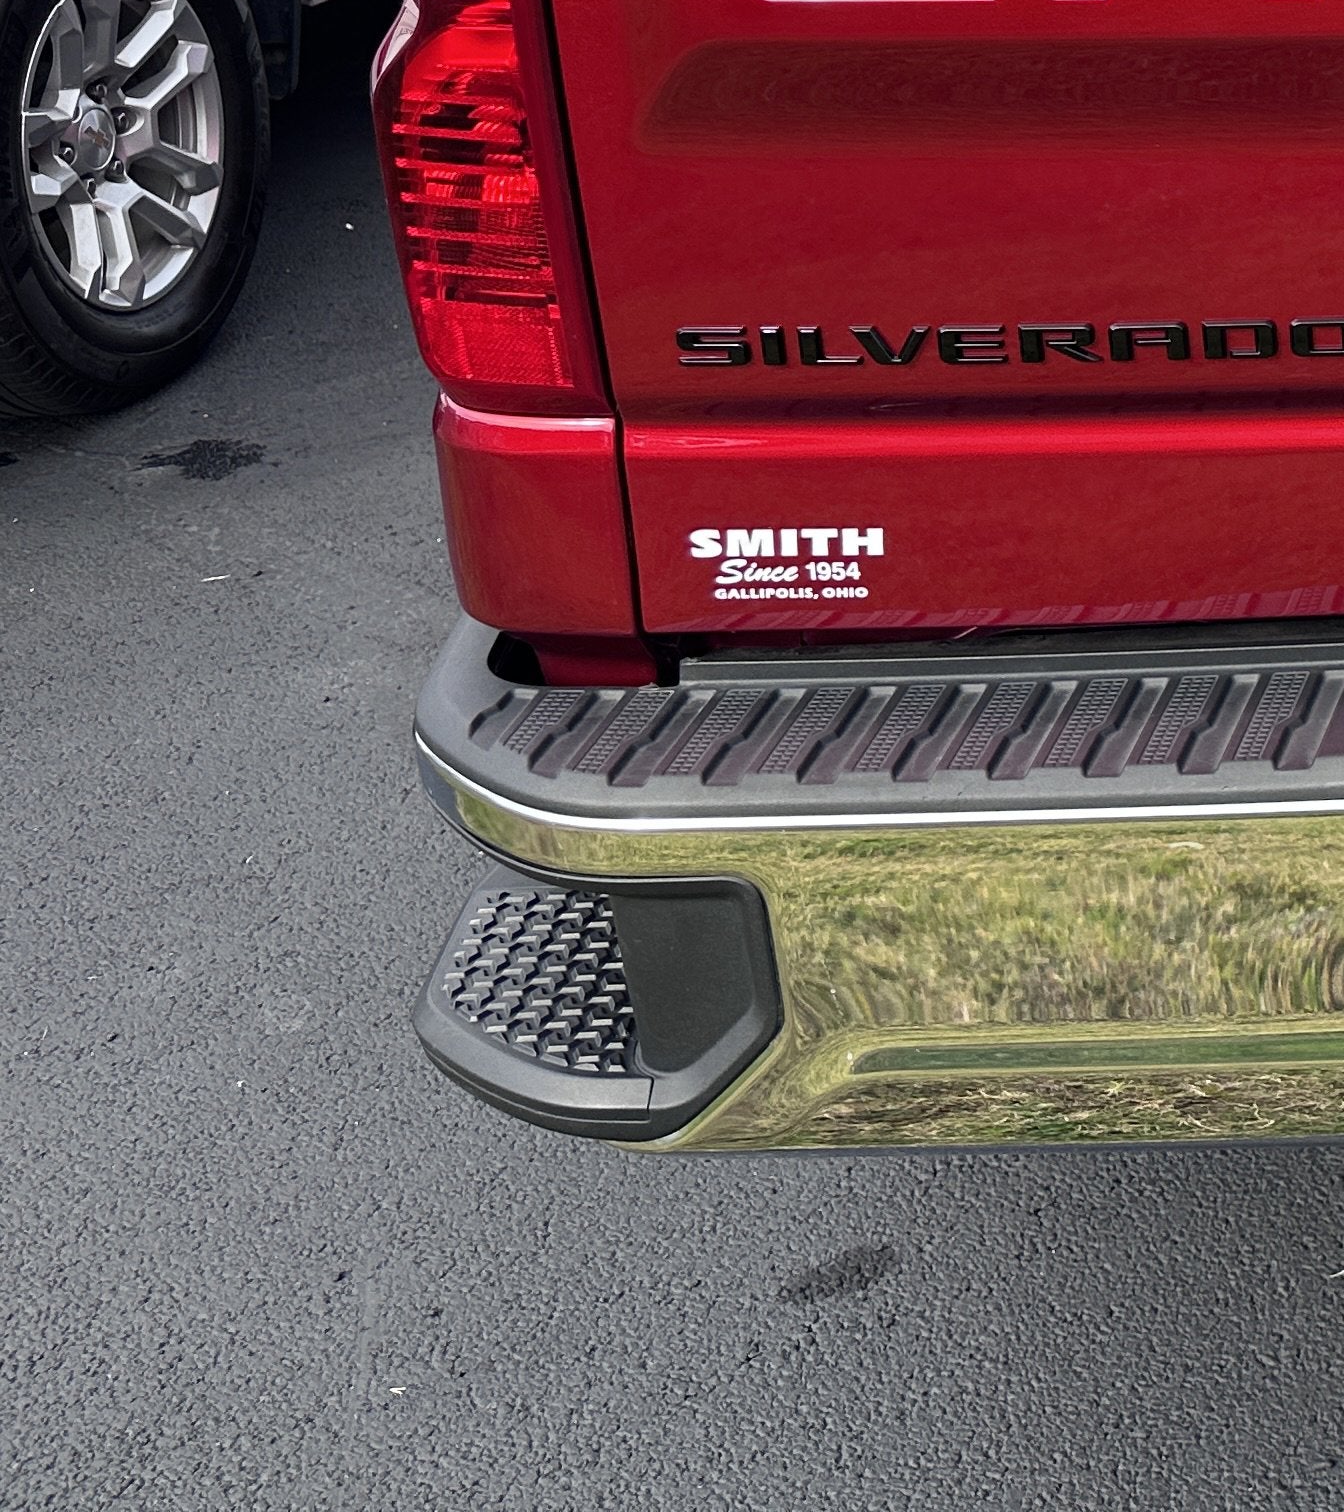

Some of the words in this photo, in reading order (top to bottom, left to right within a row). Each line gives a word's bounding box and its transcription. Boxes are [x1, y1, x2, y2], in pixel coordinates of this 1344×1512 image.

[688, 527, 885, 559] SMITH
[714, 558, 800, 585] Since
[804, 561, 862, 581] 1954
[714, 587, 820, 600] GALLIPOLIS,
[821, 586, 869, 599] OHIO
